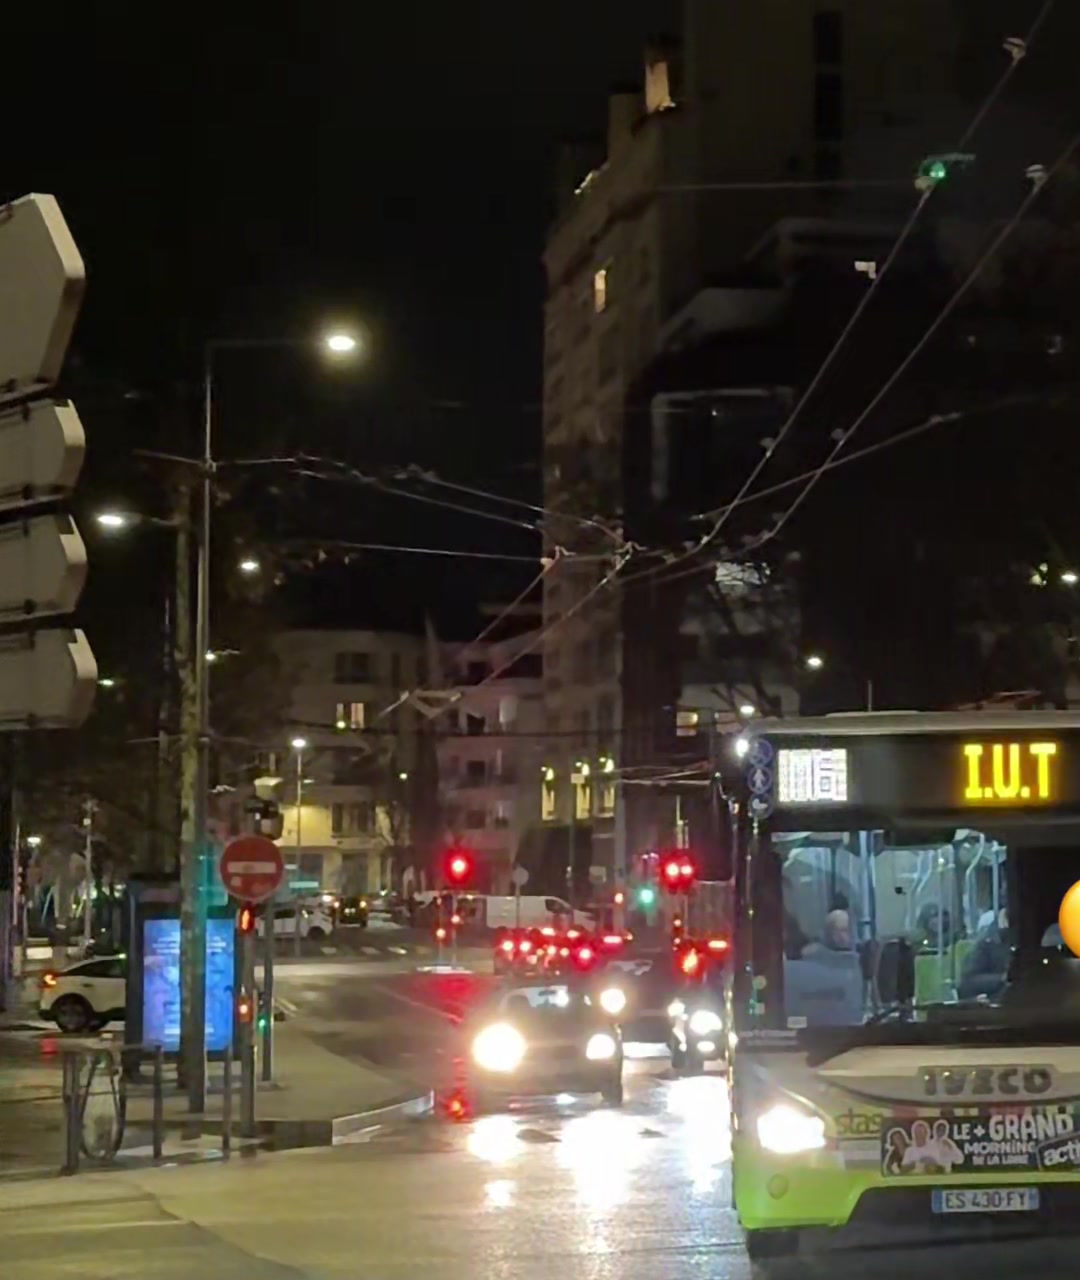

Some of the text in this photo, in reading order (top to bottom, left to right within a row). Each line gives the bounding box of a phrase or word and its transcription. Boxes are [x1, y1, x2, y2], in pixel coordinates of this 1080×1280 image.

[963, 742, 1057, 799] I.U.T
[925, 1068, 1052, 1095] IVECO
[953, 1124, 970, 1141] LE
[989, 1114, 1073, 1141] GRAND
